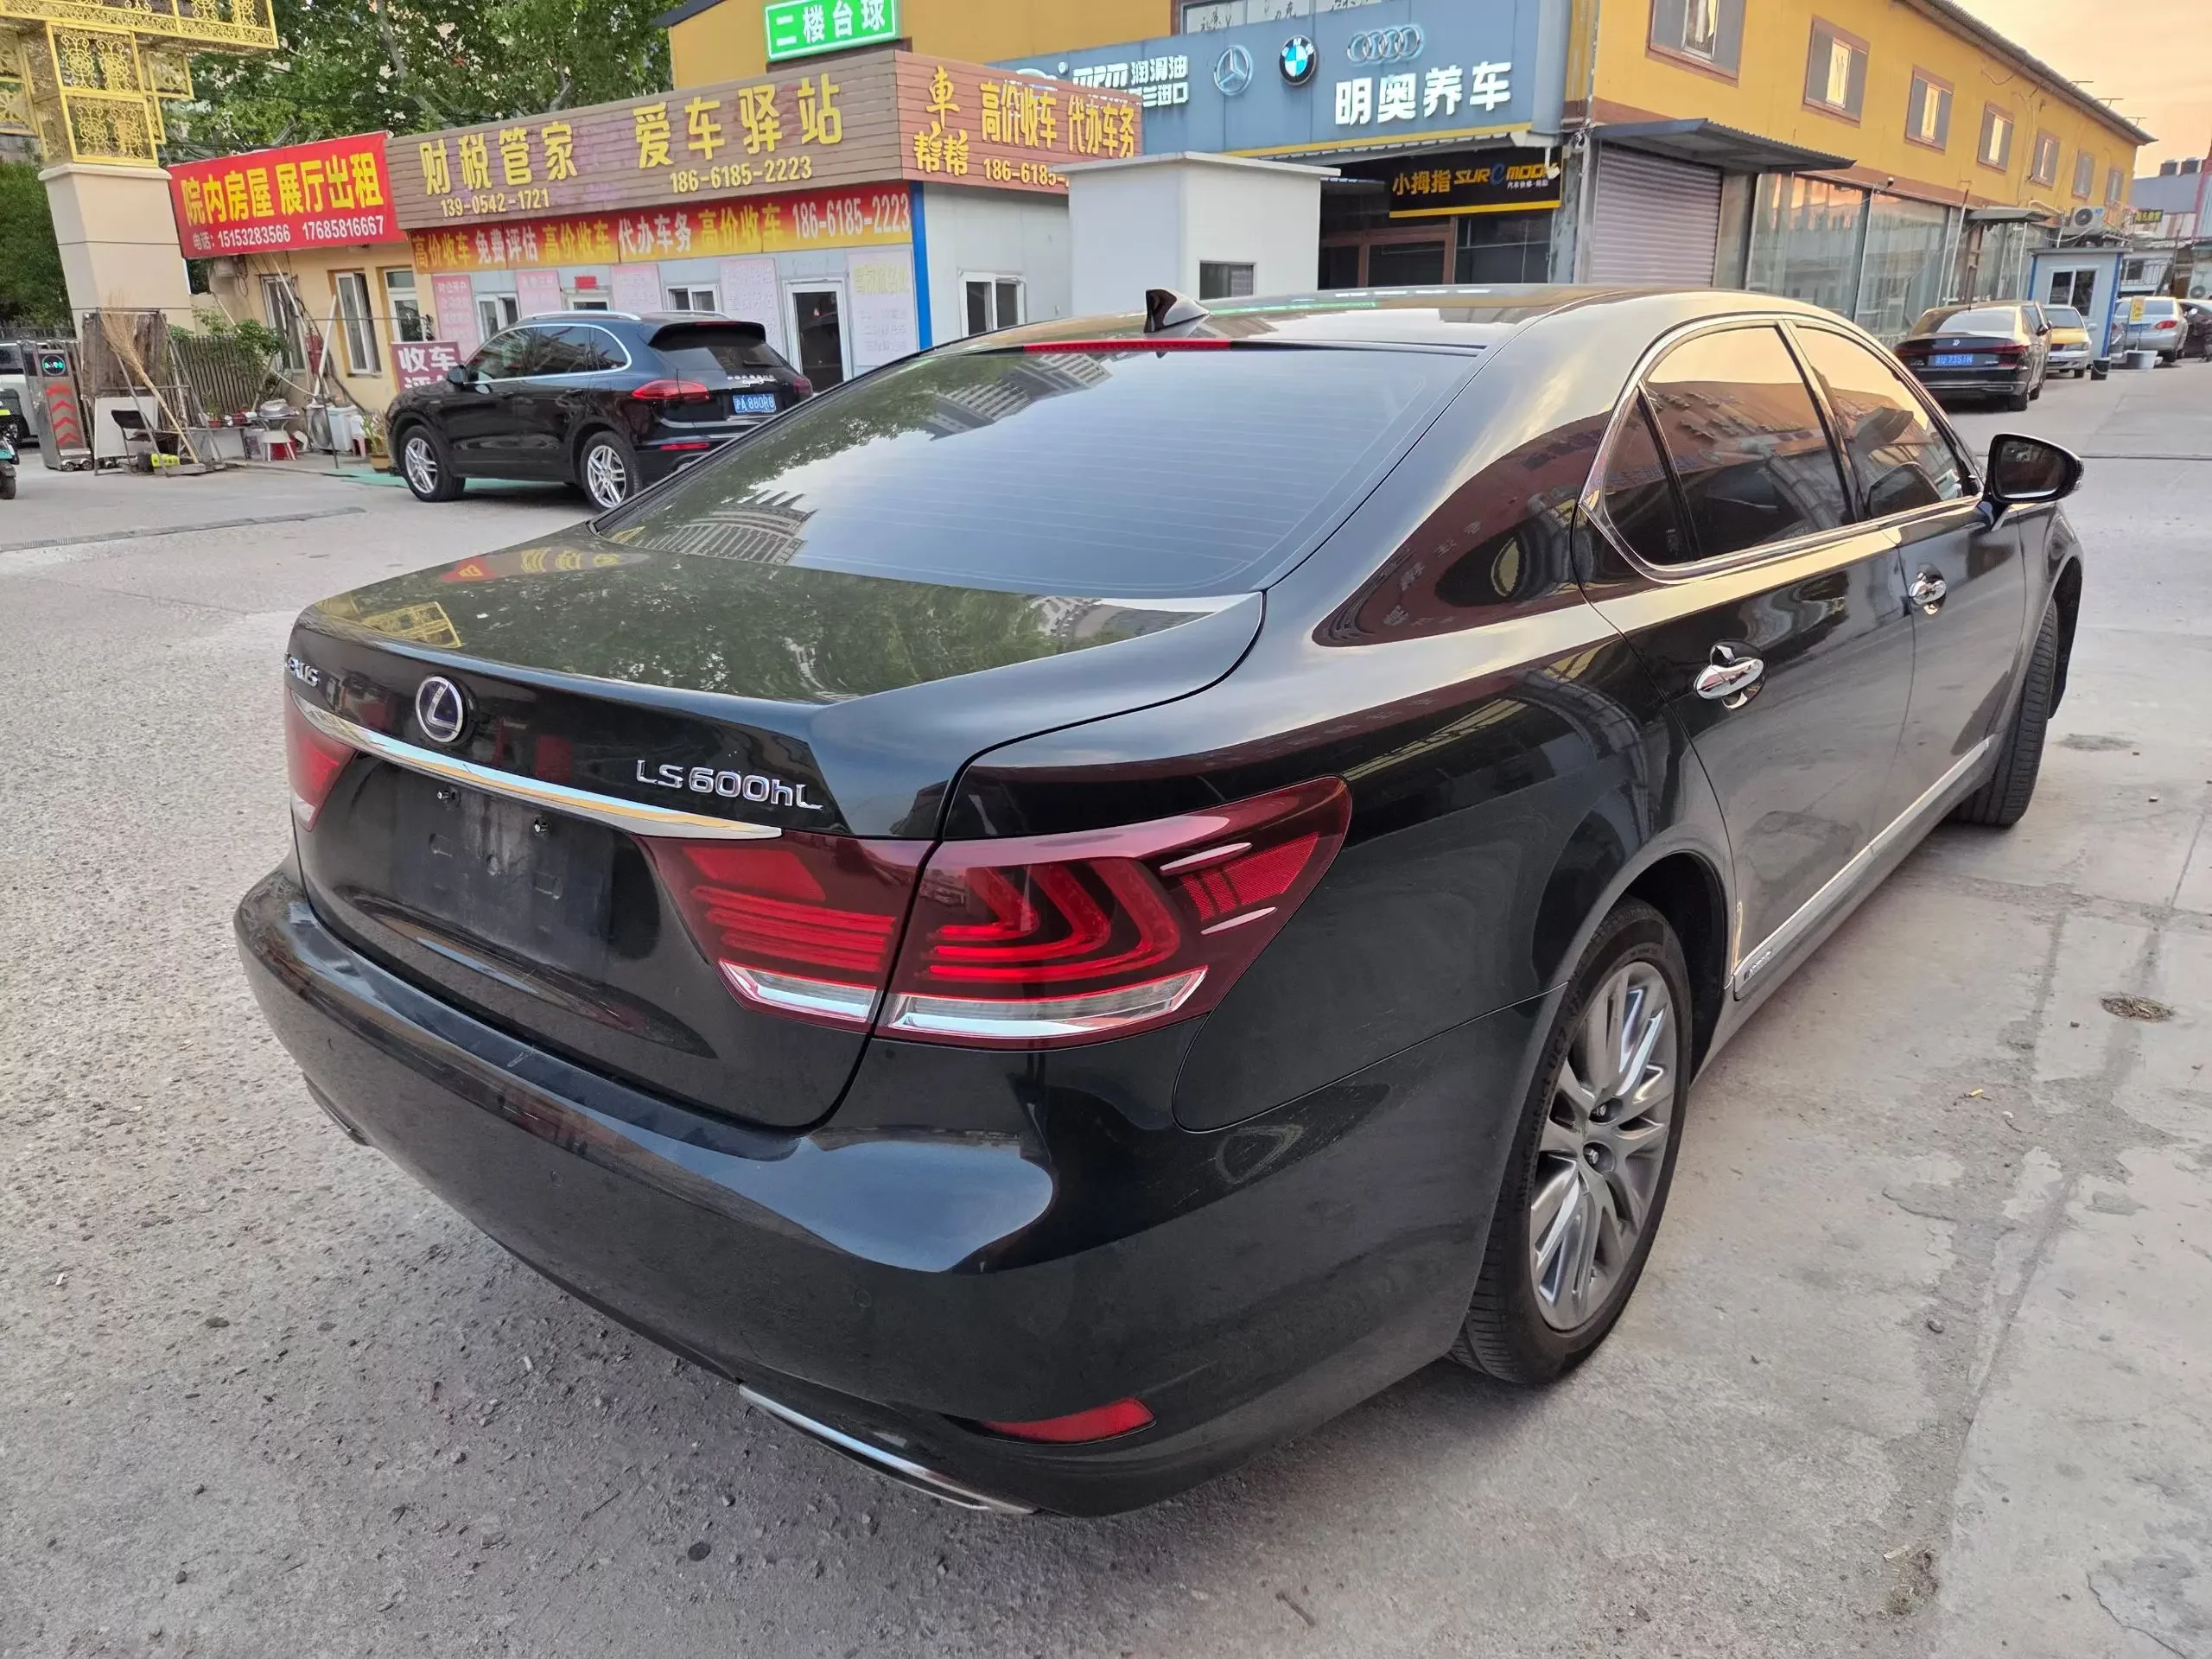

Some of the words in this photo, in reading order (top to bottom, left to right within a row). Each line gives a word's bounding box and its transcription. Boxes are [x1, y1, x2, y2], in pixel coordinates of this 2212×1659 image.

[775, 0, 886, 47] 二楼台球
[1130, 54, 1189, 85] 润滑油
[1334, 60, 1512, 126] 明奥养车
[632, 73, 843, 170] 爱车驿站
[980, 79, 1058, 149] 高价收车
[1067, 94, 1135, 159] 代办车务
[419, 121, 578, 196] 财税管家
[670, 155, 812, 194] 186-6185-2223
[983, 158, 1070, 188] 186-6185-
[180, 167, 275, 227] 院内房屋
[275, 151, 385, 216] 展厅出租
[440, 188, 550, 218] 139-0542-1721
[1392, 169, 1452, 195] 小拇指
[302, 215, 385, 241] 17685816667
[411, 231, 472, 269] 高价收车
[474, 225, 540, 265] 免费评估
[542, 219, 611, 263] 高价收车
[618, 211, 692, 257] 代办车务
[697, 202, 785, 249] 高价收车
[791, 193, 911, 239] 186-6185-2223
[397, 346, 459, 374] 收车
